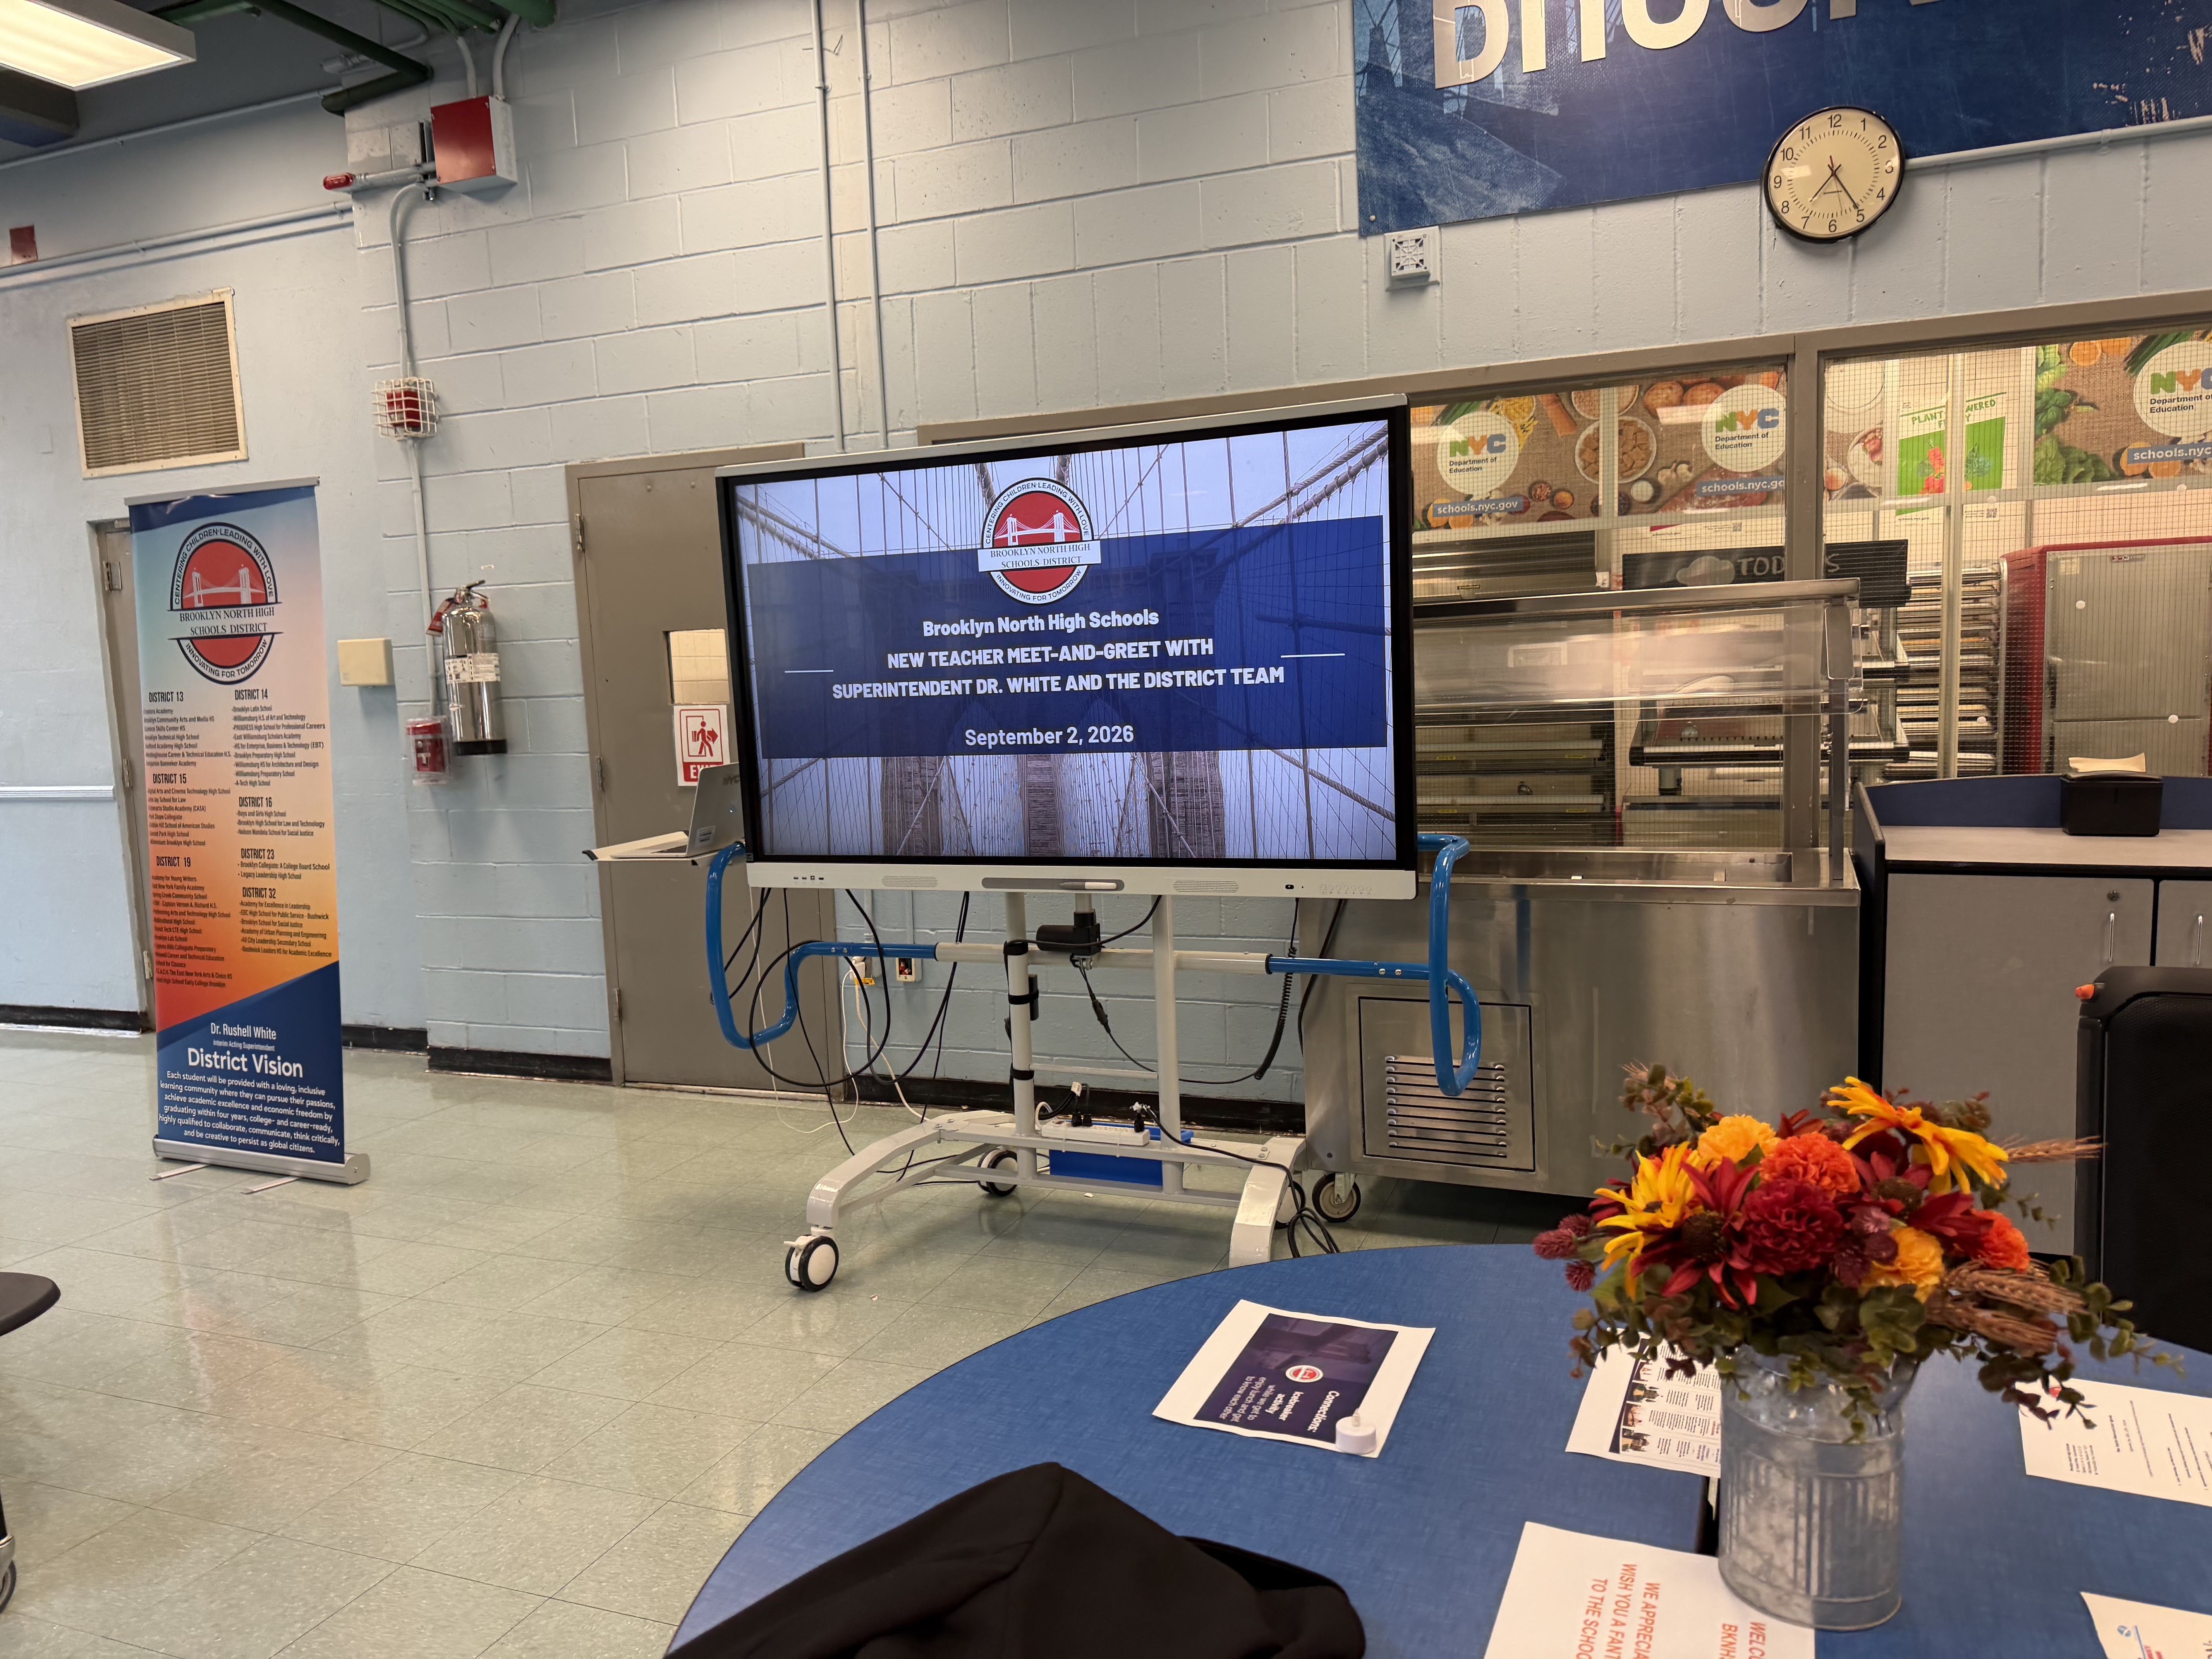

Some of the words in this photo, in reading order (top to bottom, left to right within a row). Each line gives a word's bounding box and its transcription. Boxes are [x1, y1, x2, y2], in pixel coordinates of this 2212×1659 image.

[1827, 114, 1842, 128] 12
[1861, 118, 1866, 131] 1
[1799, 126, 1810, 140] 11
[1878, 135, 1887, 148] 2
[1780, 148, 1794, 161] 10
[1884, 160, 1893, 173] 3
[1774, 175, 1782, 188] 9
[1876, 187, 1885, 201] 4
[1781, 201, 1790, 213] 8
[1856, 208, 1865, 222] 5
[1802, 216, 1810, 230] 7
[1828, 220, 1837, 232] 6
[2150, 395, 2202, 405] Department
[2150, 404, 2194, 413] Education
[1716, 408, 1779, 433] NYC
[1715, 433, 1759, 443] Department
[1449, 434, 1506, 457] NYC
[1715, 441, 1753, 450] Education
[1449, 458, 1488, 466] Department
[986, 501, 1003, 544] CENTERING
[1003, 483, 1036, 502] CHILDREN
[1038, 483, 1067, 498] LEADING
[1068, 496, 1081, 514] WITH
[1079, 515, 1089, 536] LOVE
[1437, 501, 1518, 514] schools.nyc.gov
[991, 548, 1035, 557] BROOKLYN
[175, 552, 187, 605] CENTERING
[186, 529, 218, 552] CHILDREN
[220, 529, 252, 549] LEADING
[253, 546, 268, 570] WITH
[265, 570, 274, 597] LOVE
[1002, 560, 1039, 568] SCHOOLS
[1044, 556, 1081, 565] DISTRICT
[996, 574, 1030, 600] INNOVATING
[1048, 569, 1081, 599] TOMORROW
[180, 611, 221, 622] BROOKLYN
[224, 609, 253, 619] NORTH
[256, 607, 274, 617] HIGH
[191, 625, 226, 635] SCHOOLS
[230, 623, 267, 633] DISTRICT
[923, 619, 994, 637] Brooklyn
[998, 615, 1044, 632] North
[1048, 613, 1085, 633] High
[1089, 609, 1159, 627] Schools
[185, 642, 220, 677] INNOVATING
[237, 639, 268, 677] TOMORROW
[888, 653, 924, 668] NEW
[928, 649, 1004, 666] TEACHER
[1008, 641, 1161, 663] MEET-AND-GREET
[1165, 638, 1213, 656] WITH
[833, 680, 972, 698] SUPERINTENDENT
[976, 679, 1003, 694] DR.
[1006, 676, 1061, 692] WHITE
[1065, 675, 1102, 690] AND
[1106, 673, 1140, 689] THE
[1144, 669, 1226, 688] DISTRICT
[1230, 667, 1284, 684] TEAM
[149, 692, 173, 702] DISTRICT
[177, 692, 183, 701] 13
[235, 689, 259, 700] DISTRICT
[262, 689, 268, 699] 14
[965, 728, 1063, 749] September
[1067, 727, 1082, 745] 2,
[1088, 725, 1133, 743] 2026
[153, 774, 177, 783] DISTRICT
[180, 774, 186, 783] 15
[239, 797, 263, 807] DISTRICT
[266, 797, 272, 807] 16
[241, 848, 265, 859] DISTRICT
[267, 849, 274, 859] 23
[156, 856, 180, 866] DISTRICT
[184, 857, 191, 867] 19
[243, 887, 267, 898] DISTRICT
[269, 888, 276, 898] 32
[211, 1023, 221, 1034] Dr.
[223, 1024, 251, 1037] Rushell
[254, 1027, 276, 1039] White
[188, 1048, 247, 1072] District
[252, 1054, 302, 1077] Vision
[167, 1071, 181, 1079] Each
[182, 1073, 206, 1082] student
[228, 1079, 254, 1087] provided
[256, 1081, 270, 1089] with
[276, 1083, 297, 1094] loving,
[298, 1085, 325, 1095] inclusive
[160, 1080, 182, 1092] learning
[184, 1085, 218, 1096] community
[219, 1088, 238, 1097] where
[240, 1090, 253, 1101] they
[306, 1100, 335, 1109] passions,
[165, 1093, 187, 1102] achieve
[188, 1096, 216, 1105] academic
[218, 1101, 249, 1109] excellence
[264, 1106, 294, 1115] economic
[296, 1108, 323, 1119] freedom
[325, 1111, 332, 1122] by
[164, 1105, 196, 1116] graduating
[198, 1108, 215, 1117] within
[217, 1110, 229, 1118] four
[231, 1114, 248, 1122] years,
[250, 1115, 275, 1126] college-
[290, 1121, 332, 1133] career-ready,
[159, 1114, 176, 1125] highly
[177, 1117, 203, 1126] qualified
[212, 1121, 247, 1133] collaborate,
[249, 1128, 292, 1139] communicate,
[294, 1132, 309, 1140] think
[311, 1135, 340, 1146] critically,
[196, 1130, 203, 1138] be
[239, 1137, 259, 1146] persist
[269, 1140, 288, 1149] global
[289, 1143, 314, 1152] citizens.
[1265, 1393, 1285, 1414] activity
[1278, 1391, 1304, 1421] Icebreaker
[1307, 1390, 1340, 1432] Connections:
[1618, 1564, 1637, 1590] WISH
[1591, 1578, 1608, 1592] TO
[1643, 1582, 1660, 1600] WE
[1586, 1596, 1604, 1618] THE
[1613, 1594, 1632, 1617] YOU
[1609, 1618, 1626, 1626] A
[1719, 1623, 1738, 1659] BKNH
[1748, 1622, 1765, 1659] WELC
